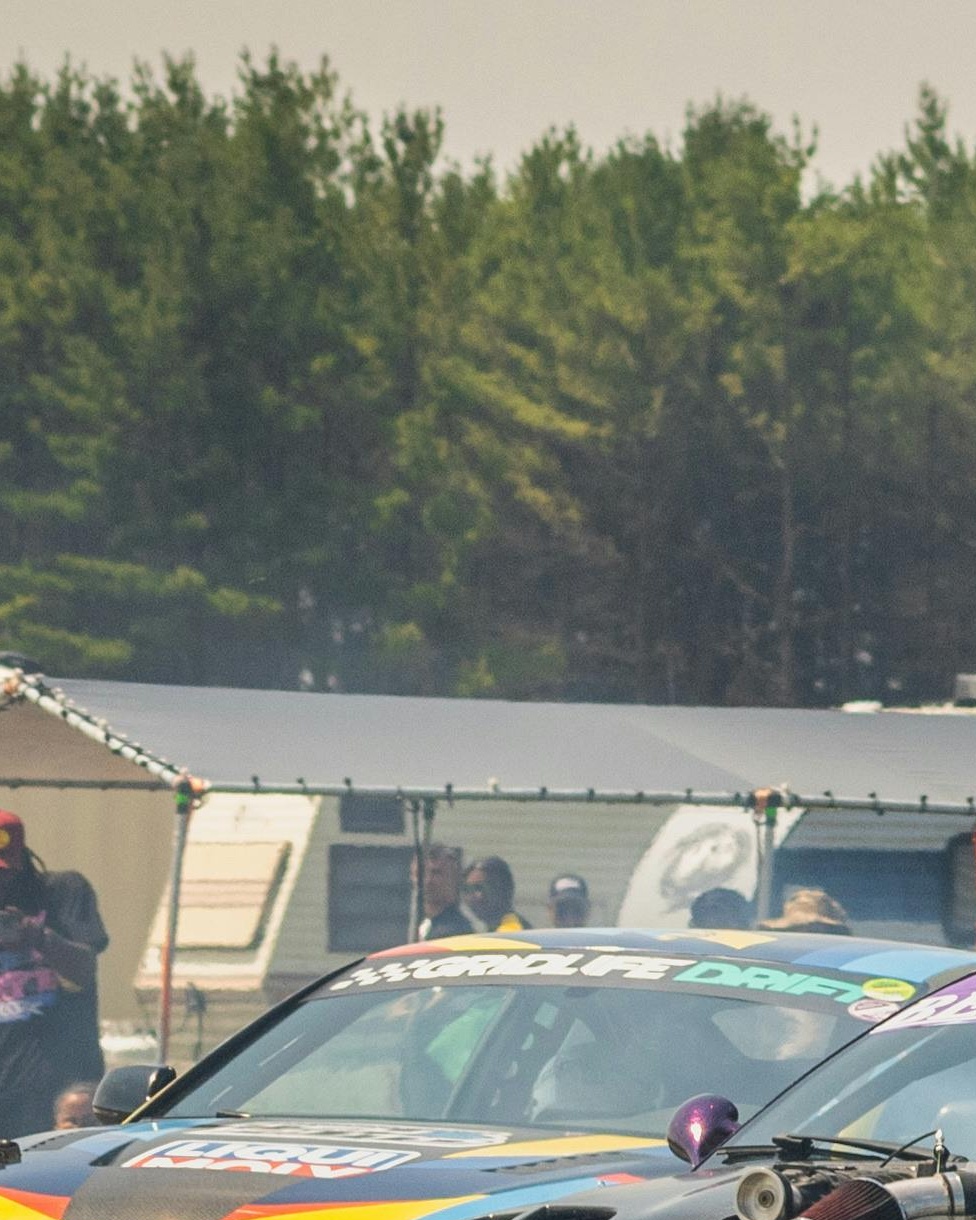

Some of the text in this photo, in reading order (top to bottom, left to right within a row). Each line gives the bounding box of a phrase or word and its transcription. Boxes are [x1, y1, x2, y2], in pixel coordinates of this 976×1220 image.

[413, 954, 697, 980] GRIDLIFE
[673, 961, 866, 1004] DRIFT
[181, 1141, 392, 1170] LIQUI
